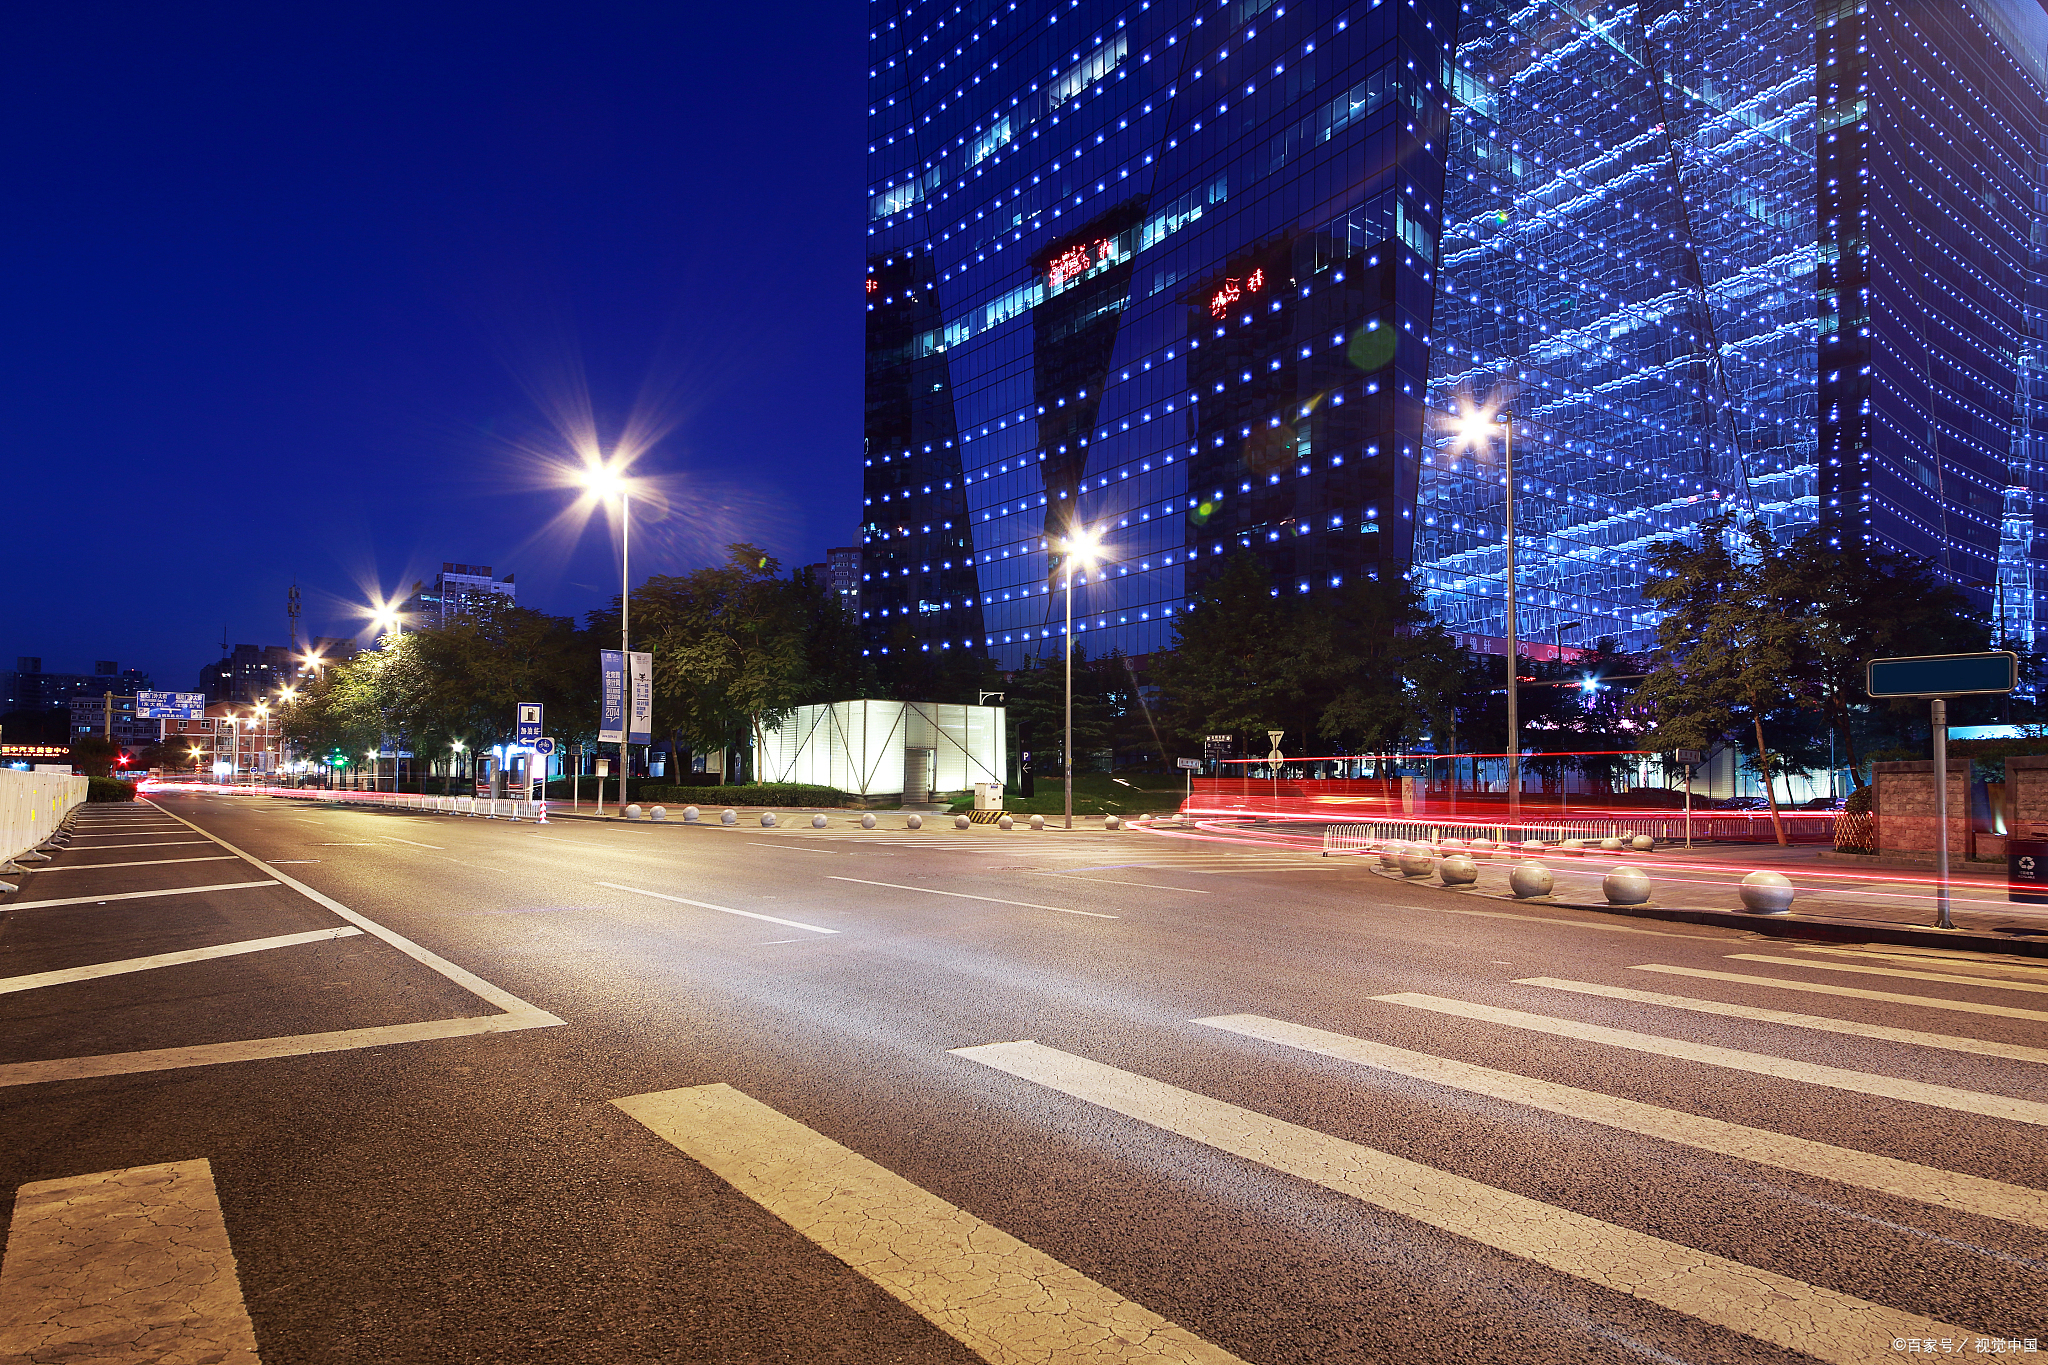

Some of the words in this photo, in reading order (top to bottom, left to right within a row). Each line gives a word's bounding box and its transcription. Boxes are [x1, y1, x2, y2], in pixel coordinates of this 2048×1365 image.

[605, 708, 620, 716] 2014
[520, 727, 541, 735] 加油站
[1023, 752, 1029, 760] P
